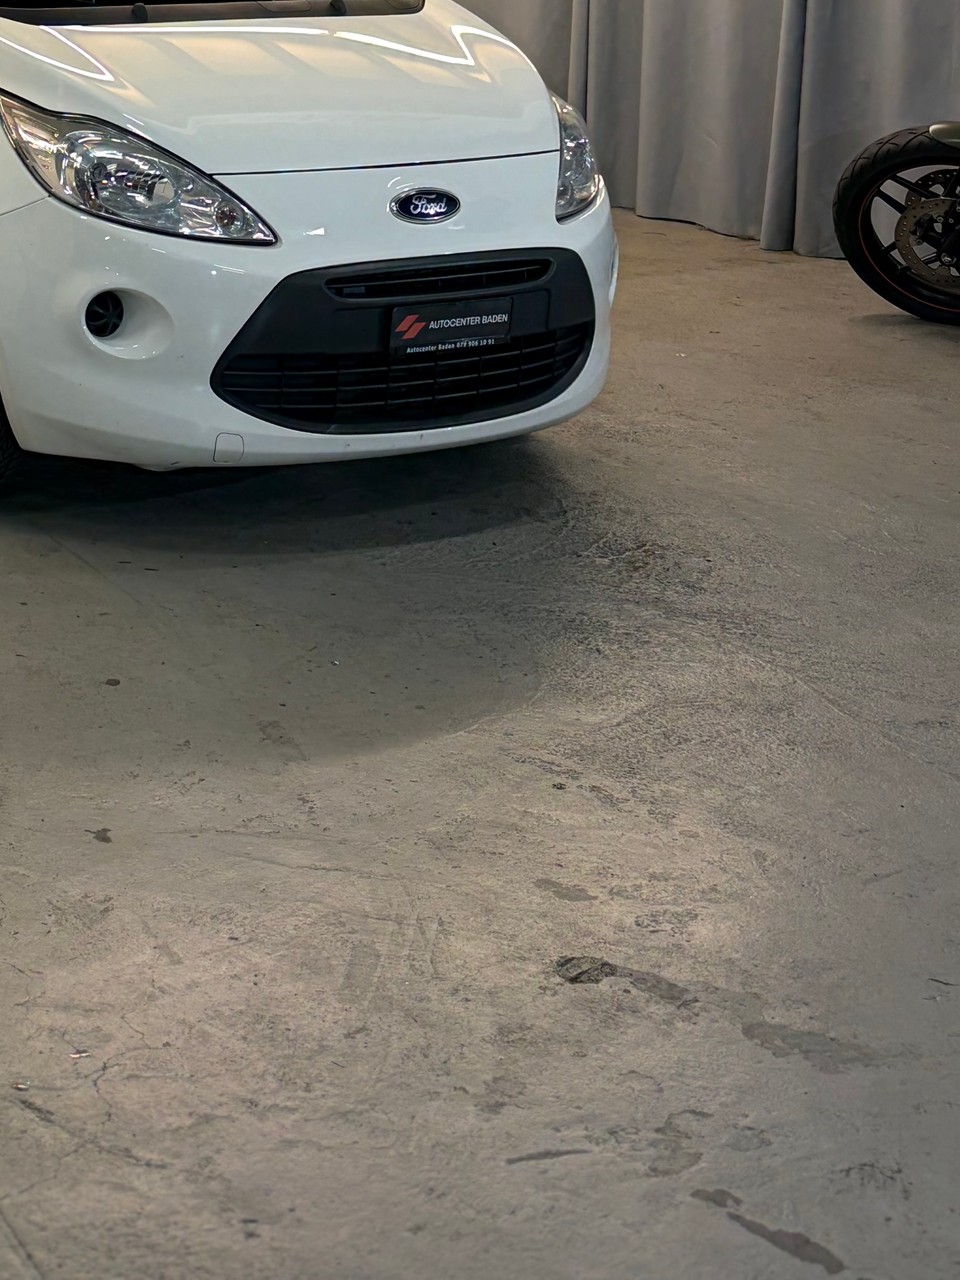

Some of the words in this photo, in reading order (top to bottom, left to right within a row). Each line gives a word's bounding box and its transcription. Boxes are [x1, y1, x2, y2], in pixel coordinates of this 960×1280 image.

[410, 194, 447, 214] Ford
[429, 317, 481, 329] AUTOCENTER
[481, 314, 508, 324] BADEN
[406, 345, 437, 353] Autocenter
[438, 343, 455, 351] Baden
